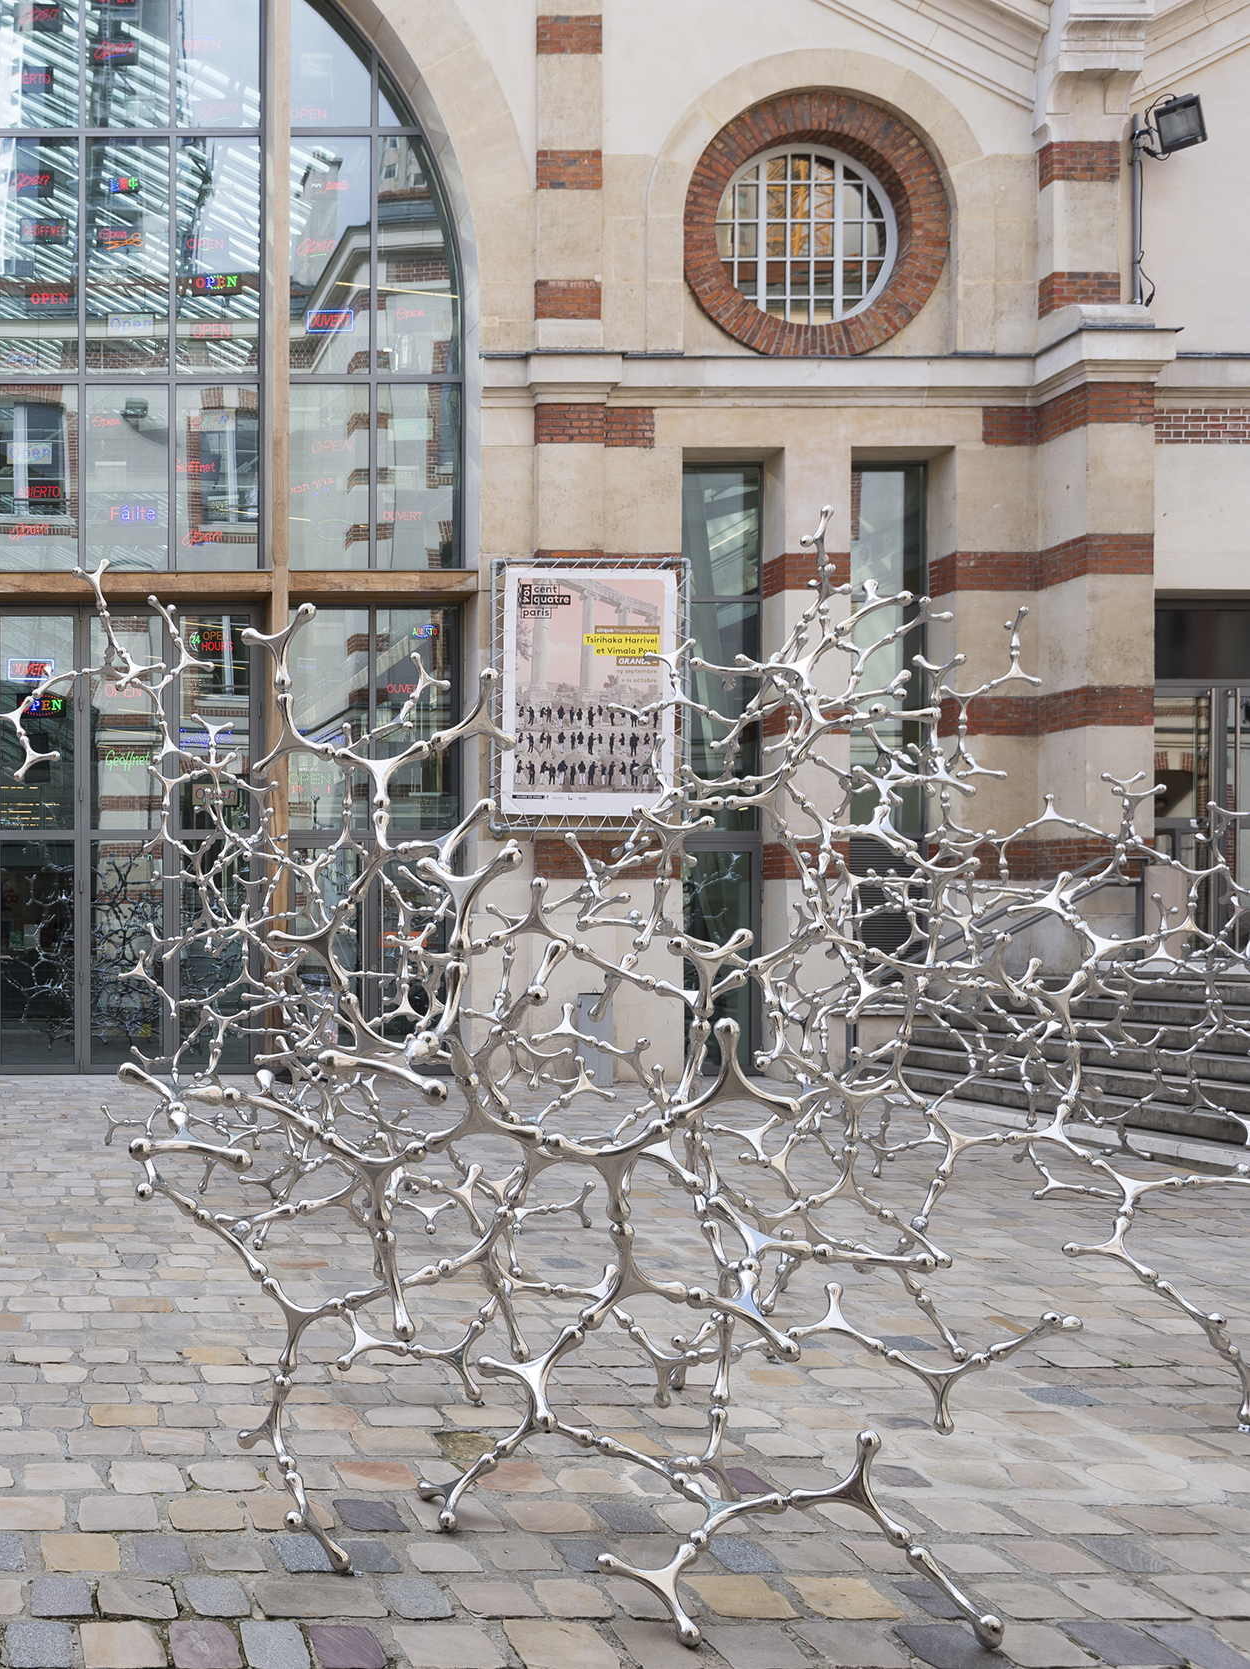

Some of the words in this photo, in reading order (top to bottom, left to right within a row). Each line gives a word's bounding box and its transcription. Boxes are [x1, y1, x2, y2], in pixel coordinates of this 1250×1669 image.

[18, 6, 59, 25] Open
[94, 41, 135, 60] Open
[183, 39, 222, 51] OPEN
[8, 73, 51, 85] ERTO
[198, 102, 238, 122] Open
[290, 108, 327, 120] OPEN
[10, 173, 50, 192] Open
[23, 224, 66, 237] GEÖFFNET
[99, 228, 128, 241] Open
[187, 238, 224, 249] OPEN
[296, 238, 337, 257] Open
[195, 276, 238, 289] OPEN
[30, 293, 69, 304] OPEN
[309, 314, 351, 327] OUVERT
[395, 307, 425, 321] Open
[110, 317, 152, 333] Open
[193, 323, 231, 338] OPEN
[7, 353, 37, 365] OPEN
[92, 415, 121, 428] Open
[192, 415, 229, 427] OPEN
[390, 424, 426, 436] OPEN
[311, 439, 354, 453] OPEN
[9, 445, 51, 463] Open
[16, 486, 61, 498] ABIERTO
[110, 505, 156, 521] Fáilte
[383, 511, 424, 522] OUVERT
[9, 523, 49, 541] Open
[181, 529, 223, 547] Open
[522, 585, 530, 603] 104
[533, 585, 557, 593] cent
[533, 596, 569, 605] quatre
[523, 608, 550, 618] paris
[191, 635, 200, 644] 24
[203, 631, 229, 640] OPEN
[586, 636, 622, 644] Tsirihaka
[625, 636, 657, 644] Harrivel
[201, 641, 233, 651] HOURS
[105, 749, 150, 772] Geöffnet
[288, 773, 331, 785] OPEN
